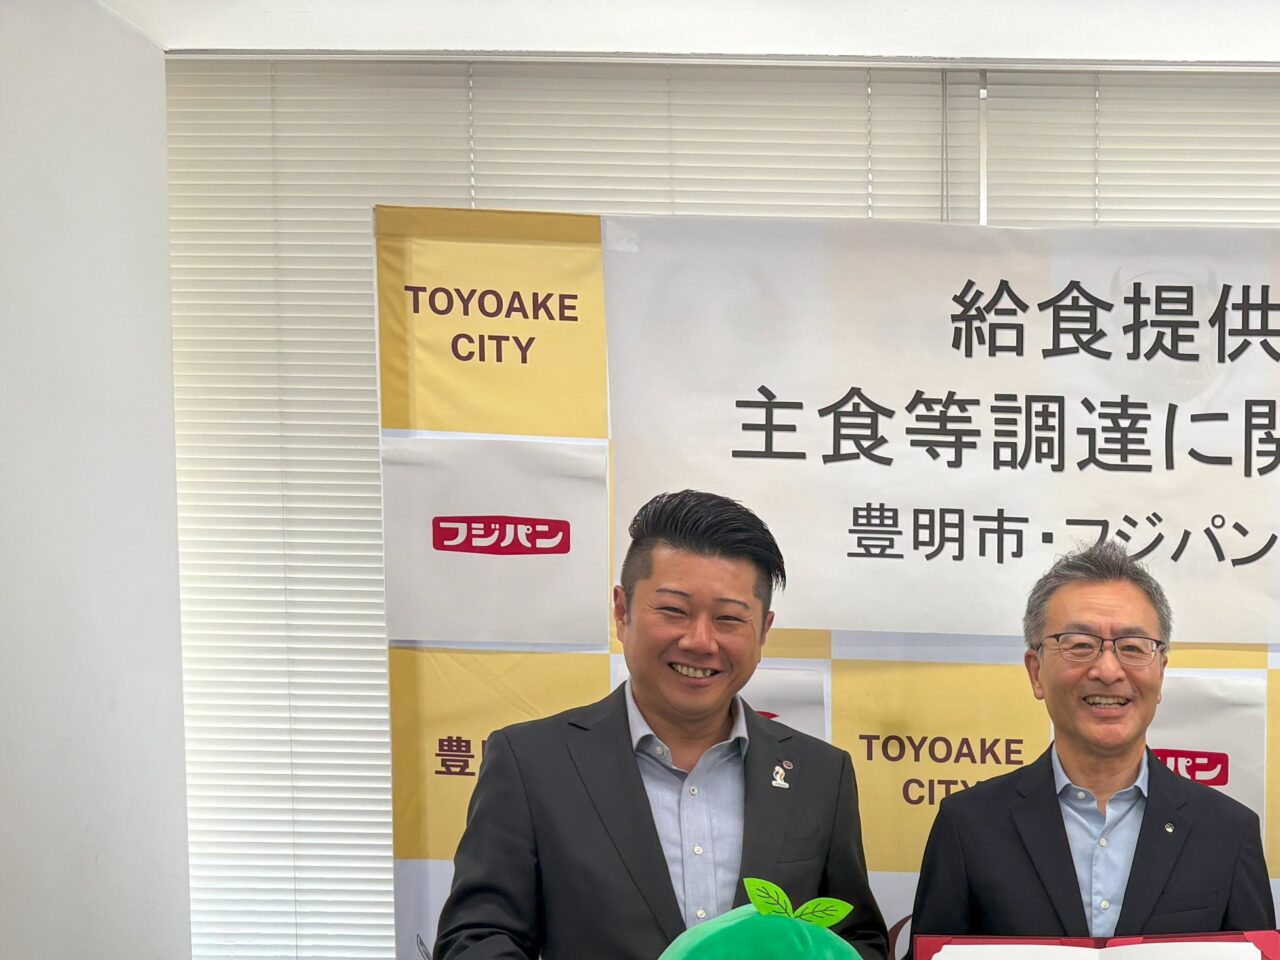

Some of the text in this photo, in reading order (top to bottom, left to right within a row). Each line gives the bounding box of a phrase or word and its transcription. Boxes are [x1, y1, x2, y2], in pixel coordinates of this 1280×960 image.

[404, 285, 579, 322] TOYOAKE
[450, 333, 536, 365] CITY
[440, 518, 564, 550] フジパン
[434, 735, 487, 776] 豊
[858, 734, 1025, 766] TOYOAKE
[902, 778, 970, 806] CIT
